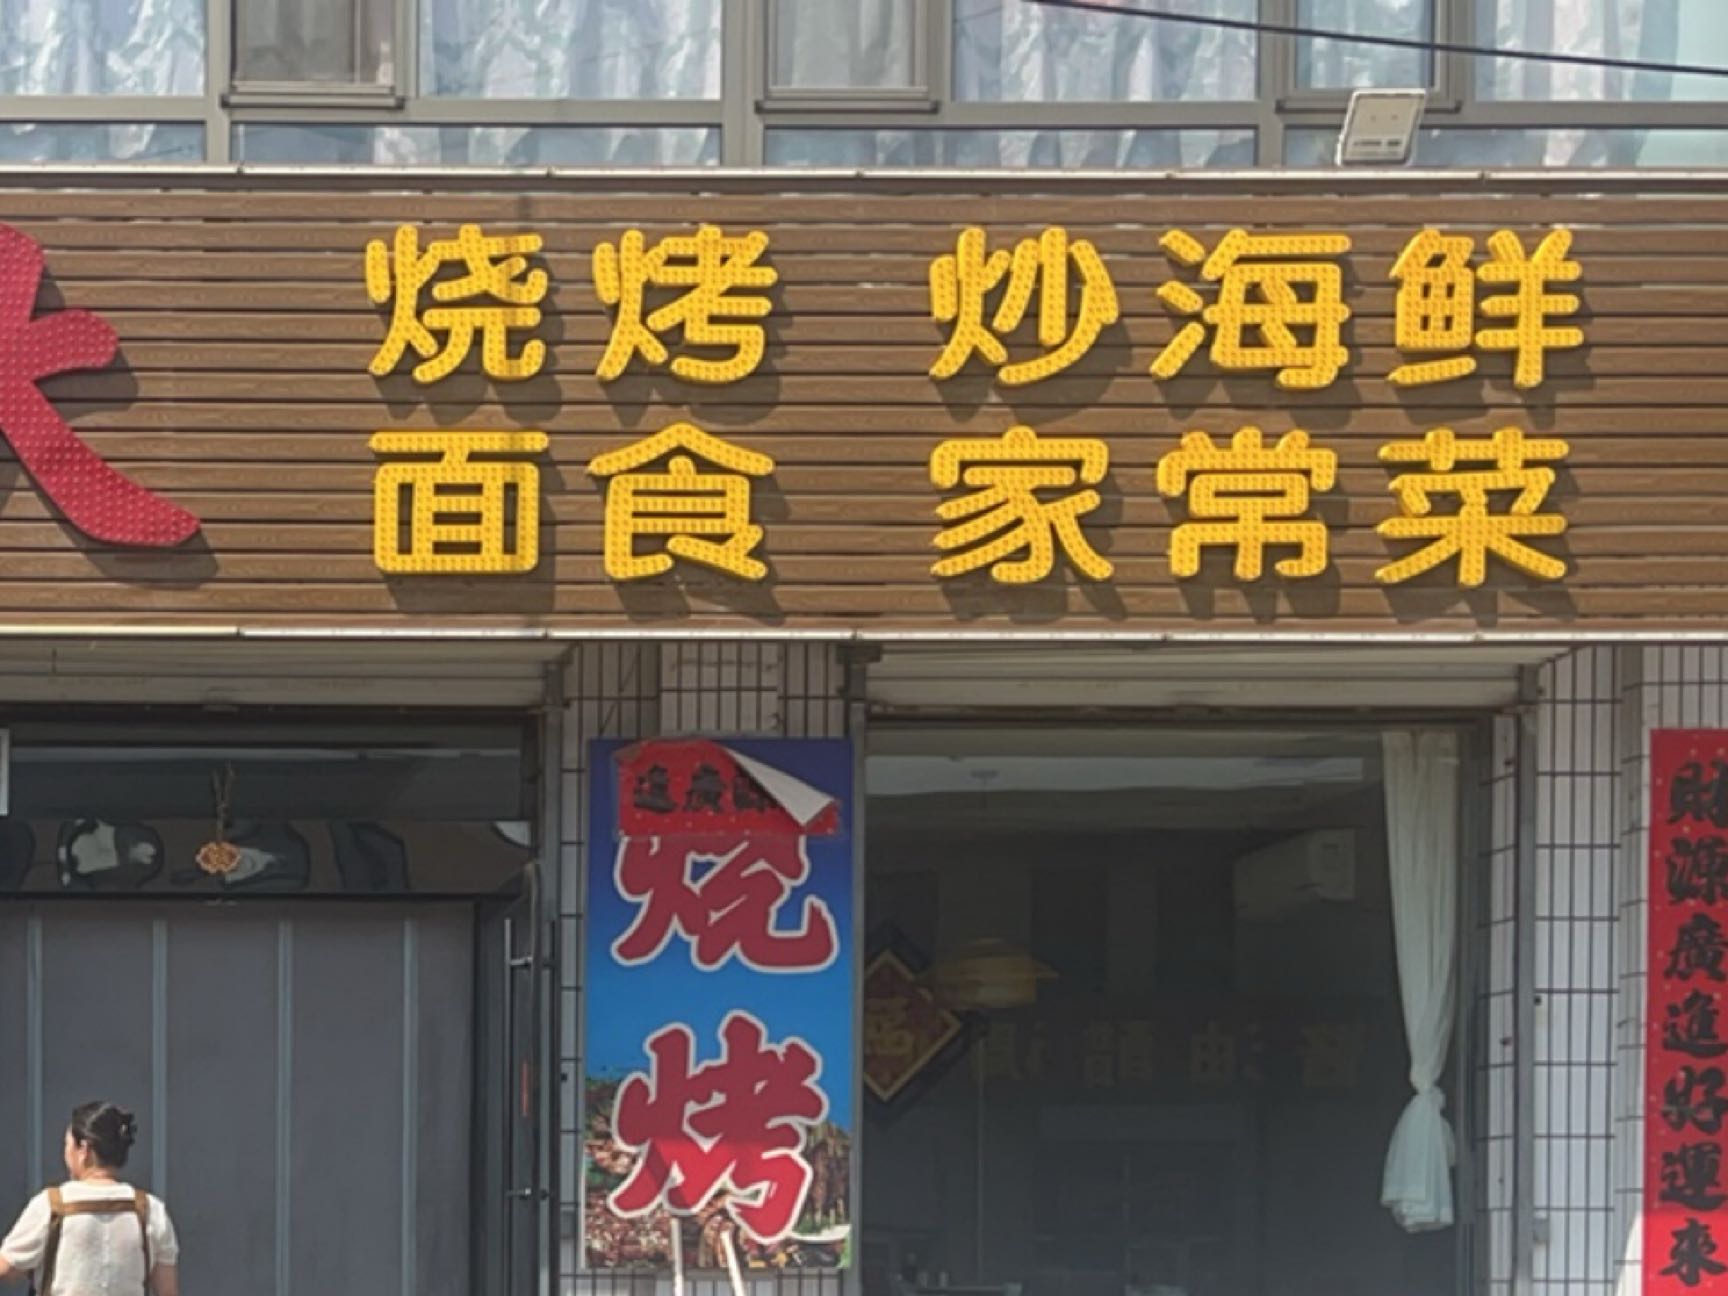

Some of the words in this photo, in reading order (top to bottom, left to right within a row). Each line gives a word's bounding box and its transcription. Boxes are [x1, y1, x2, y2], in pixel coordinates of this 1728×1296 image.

[365, 224, 778, 384] 烧烤
[928, 226, 1584, 389] 炒海鲜
[367, 423, 775, 582] 面食
[928, 427, 1570, 587] 家常菜
[608, 834, 840, 1246] 烧烤
